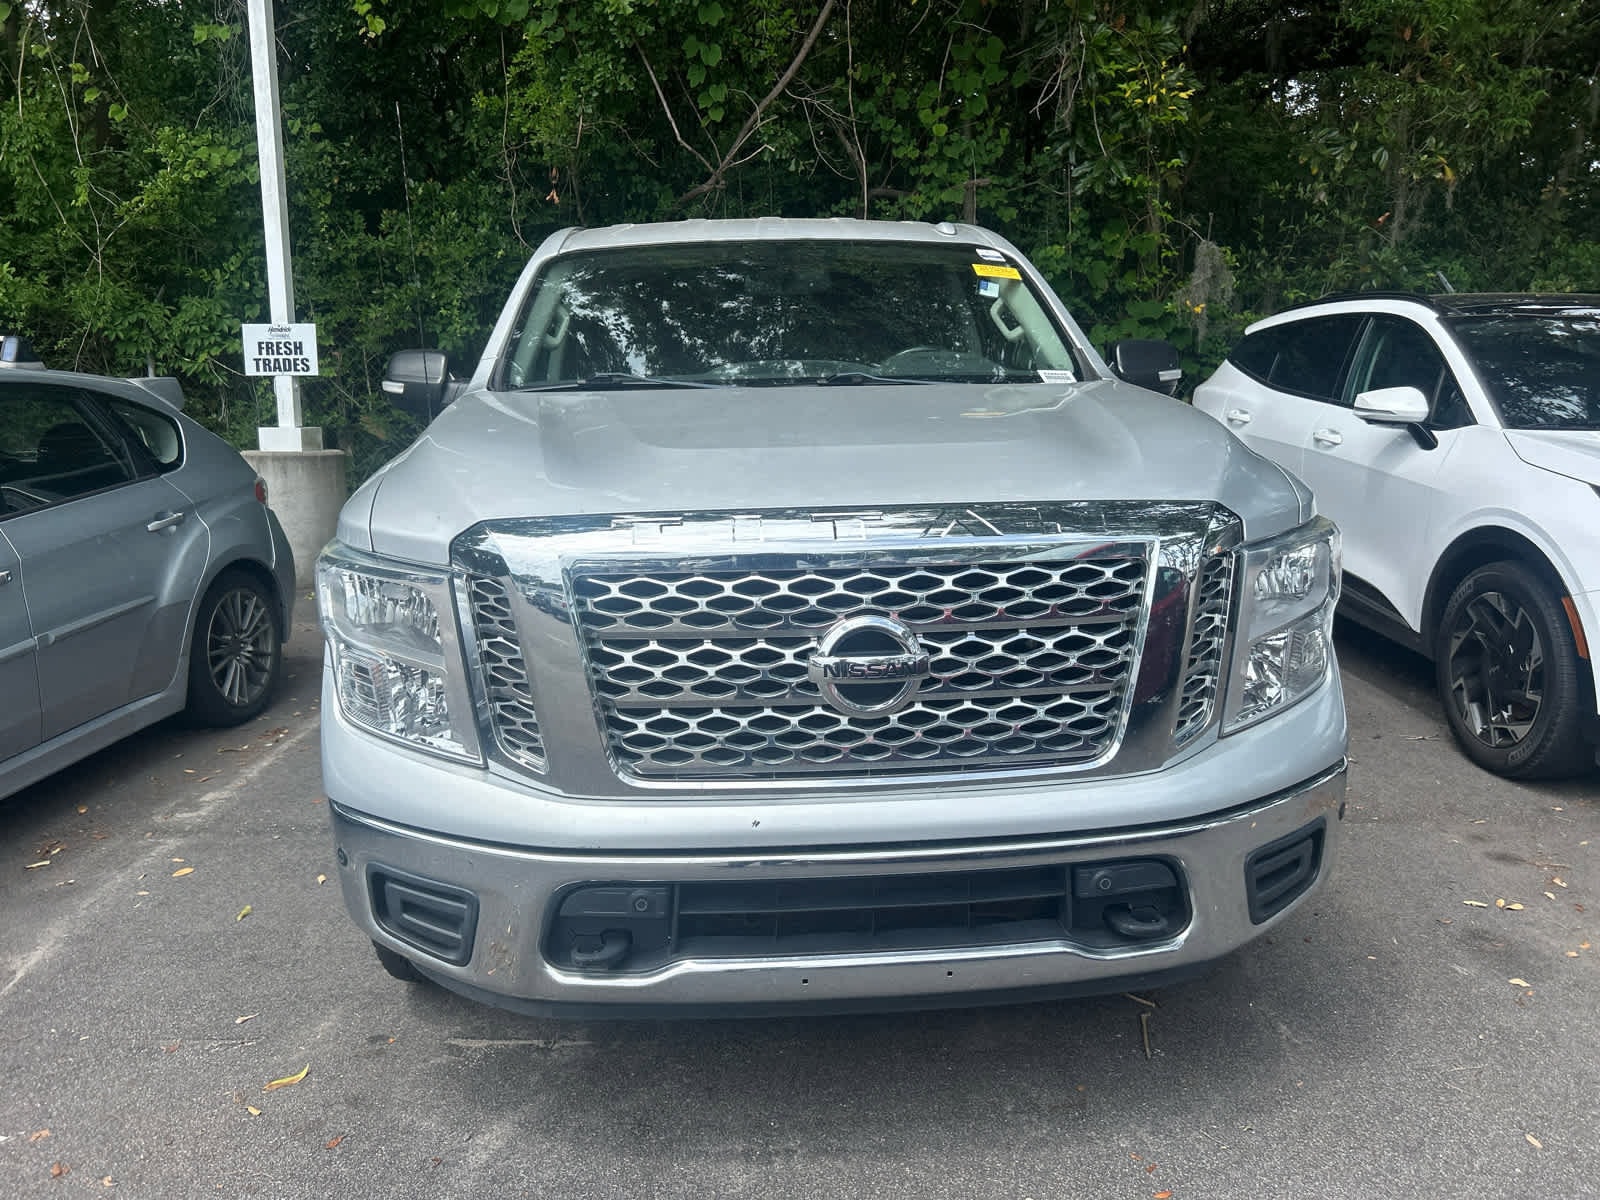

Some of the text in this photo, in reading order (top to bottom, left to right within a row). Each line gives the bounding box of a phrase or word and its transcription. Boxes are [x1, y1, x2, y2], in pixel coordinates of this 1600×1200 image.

[257, 341, 304, 356] FRESH
[253, 358, 311, 373] TRADES
[823, 660, 918, 679] NISSAN
